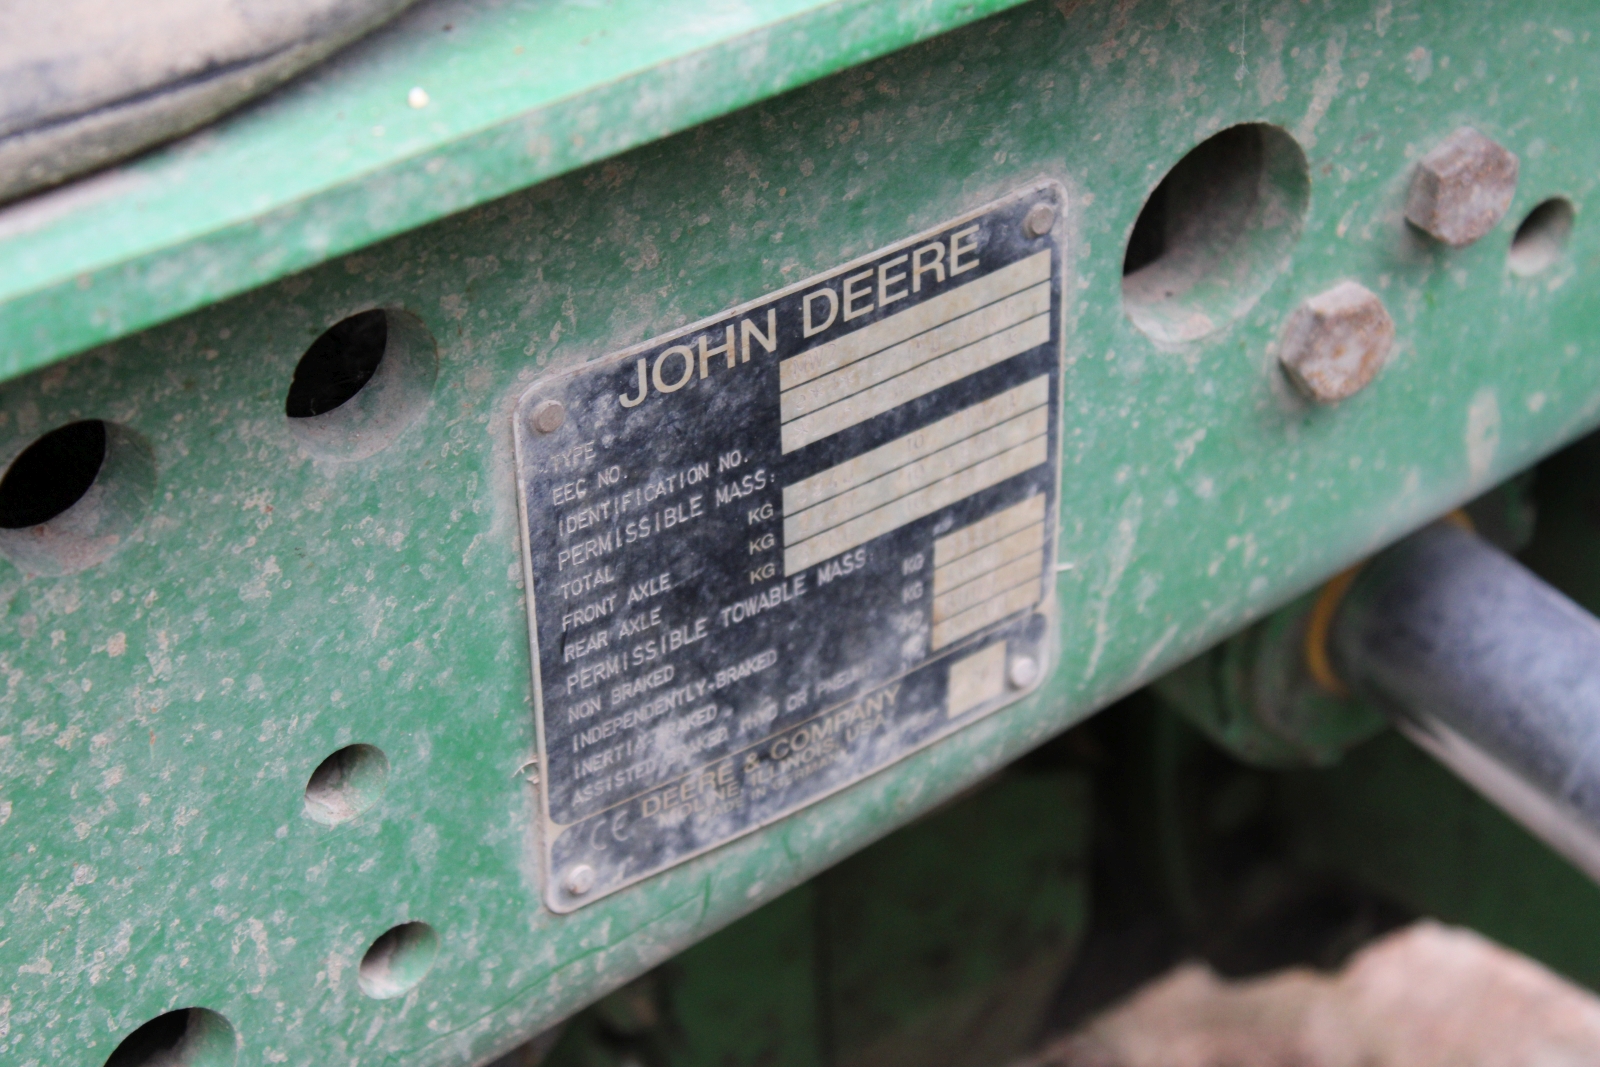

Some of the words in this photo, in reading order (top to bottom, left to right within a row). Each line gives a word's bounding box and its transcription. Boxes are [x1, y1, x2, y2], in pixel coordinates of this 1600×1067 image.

[619, 309, 777, 408] JOHN
[803, 224, 980, 338] DEERE
[550, 440, 597, 473] TYPE
[553, 479, 587, 505] EEC
[598, 465, 628, 488] NO.
[559, 462, 709, 536] IDENTIFICATION
[718, 449, 748, 472] NO.
[558, 495, 703, 571] PERMISSIBLE
[716, 469, 776, 507] MASS:
[561, 568, 615, 599] TOTAL
[748, 503, 774, 525] KG
[562, 594, 617, 632] FRONT
[627, 573, 671, 604] AXLE
[749, 533, 775, 555] KG
[564, 631, 608, 664] REAR
[619, 606, 661, 639] AXLE
[750, 563, 776, 585] KG
[567, 617, 708, 695] PERMISSIBLE
[721, 574, 807, 628] TOWABLE
[568, 695, 601, 724] NON
[611, 664, 674, 706] BRAKED
[902, 553, 924, 576] KG
[572, 649, 777, 754] INDEPENDENTLY-BRAKED
[902, 581, 923, 604] KG
[642, 762, 735, 818] DEERE
[744, 752, 760, 774] &
[770, 685, 901, 761] COMPANY
[845, 712, 886, 743] USA
[571, 757, 656, 807] ASSISTED
